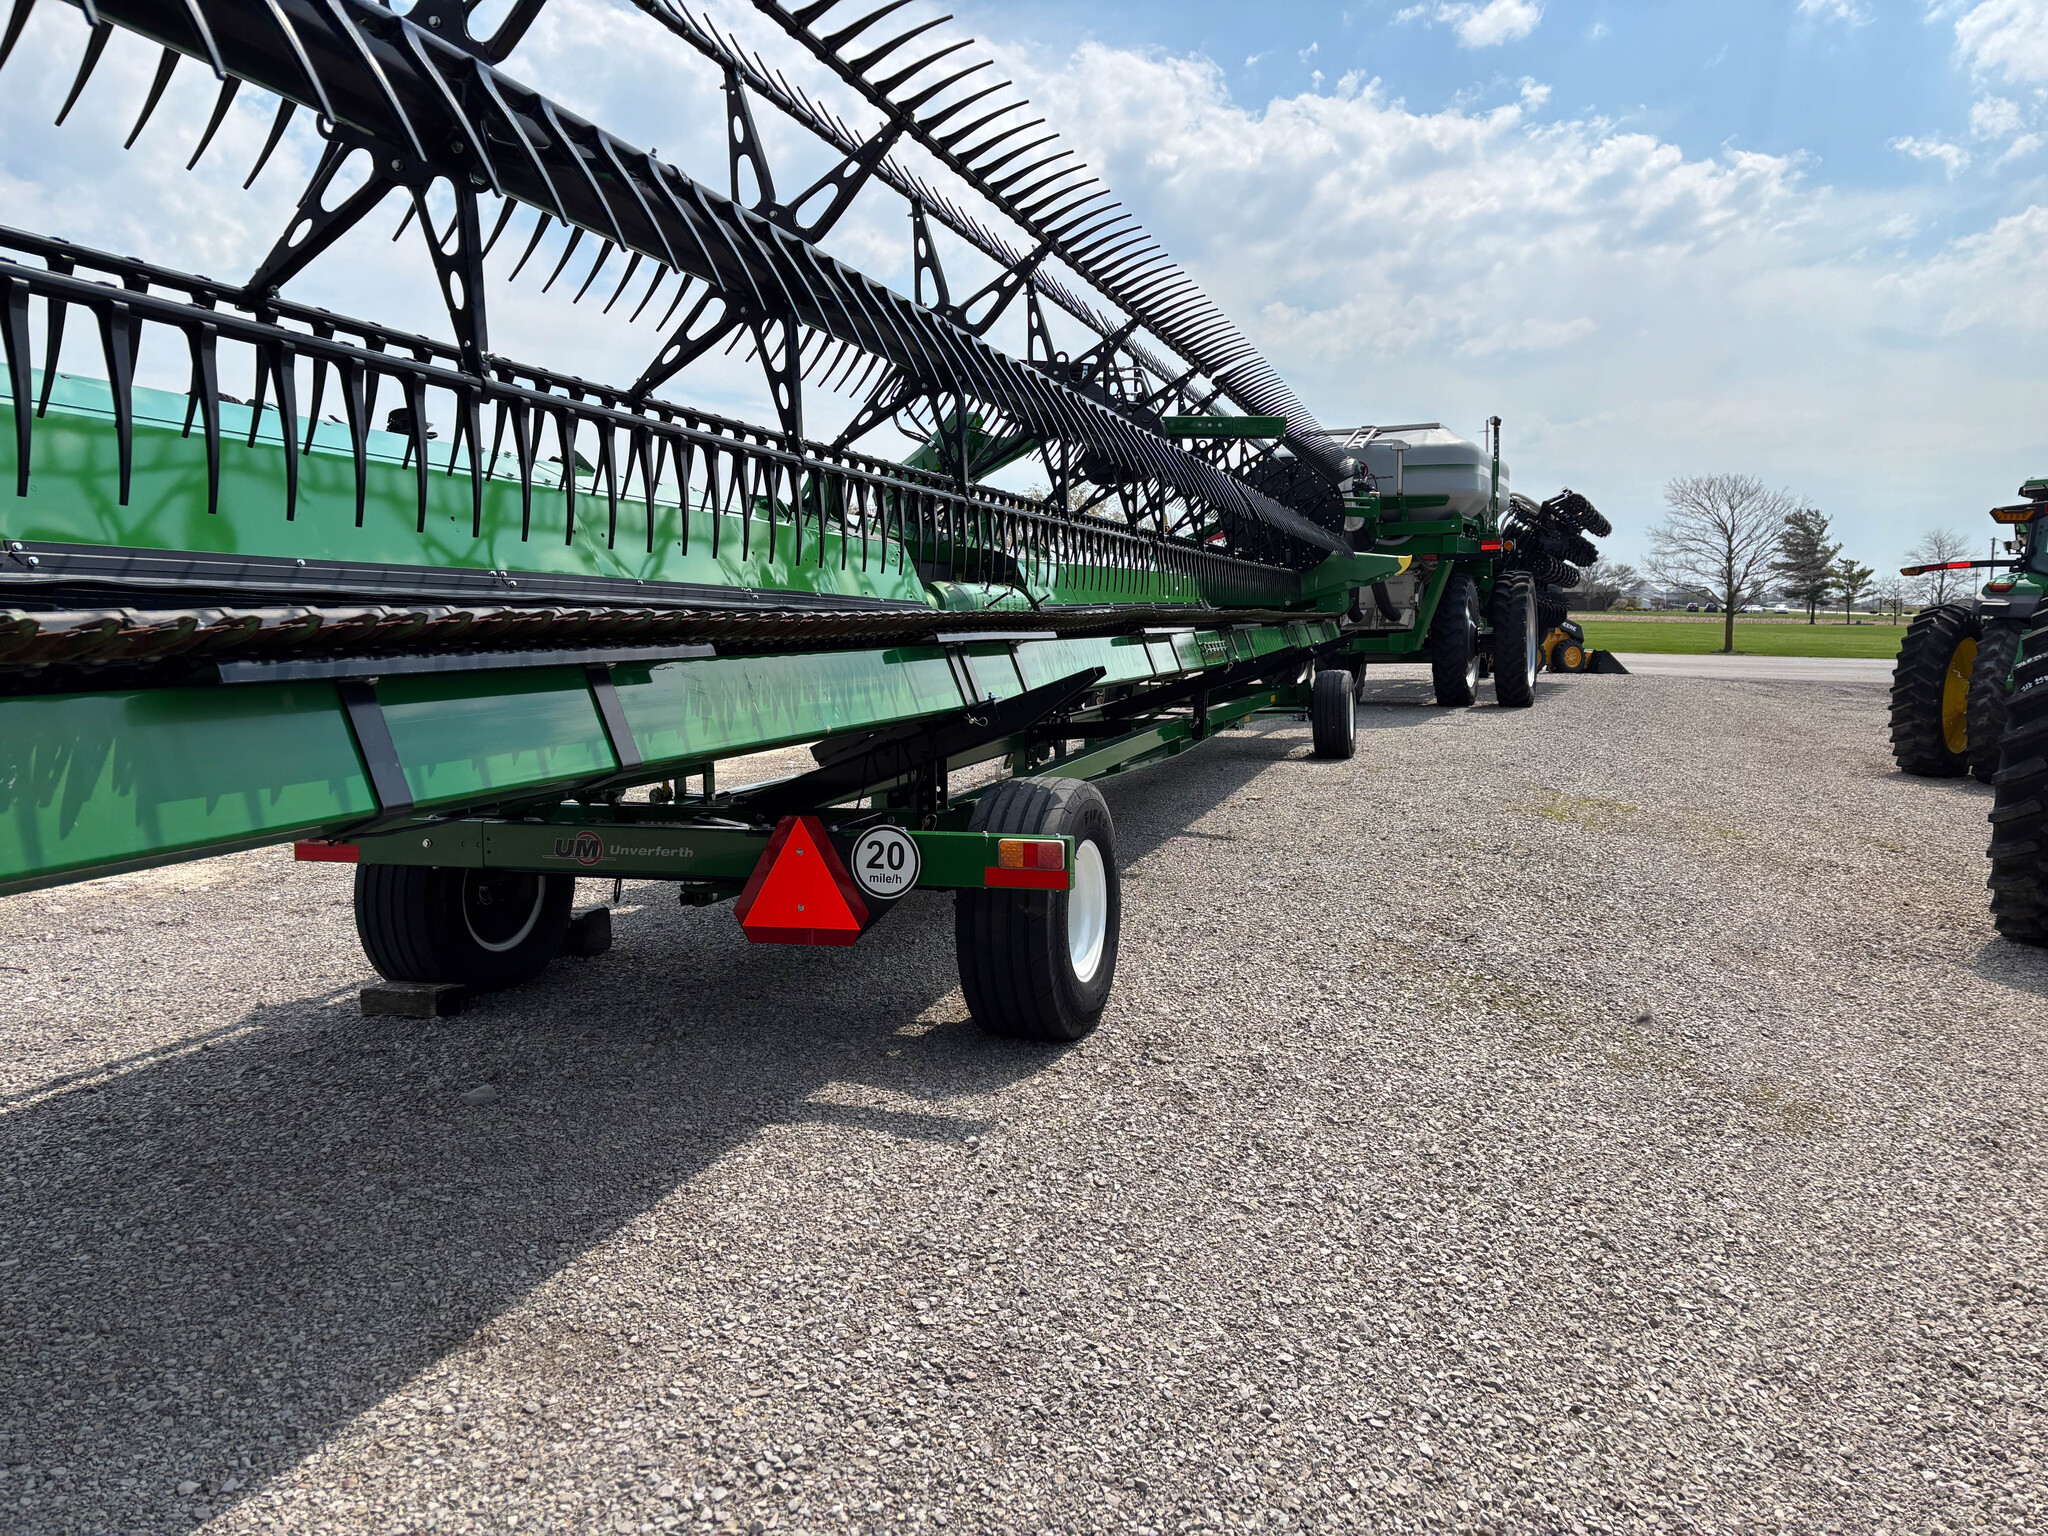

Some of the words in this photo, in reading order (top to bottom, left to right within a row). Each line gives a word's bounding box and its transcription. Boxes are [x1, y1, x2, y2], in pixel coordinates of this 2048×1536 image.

[555, 837, 600, 858] UM
[609, 845, 694, 858] Unverferth
[866, 840, 905, 871] 20
[869, 873, 903, 884] mile/h
